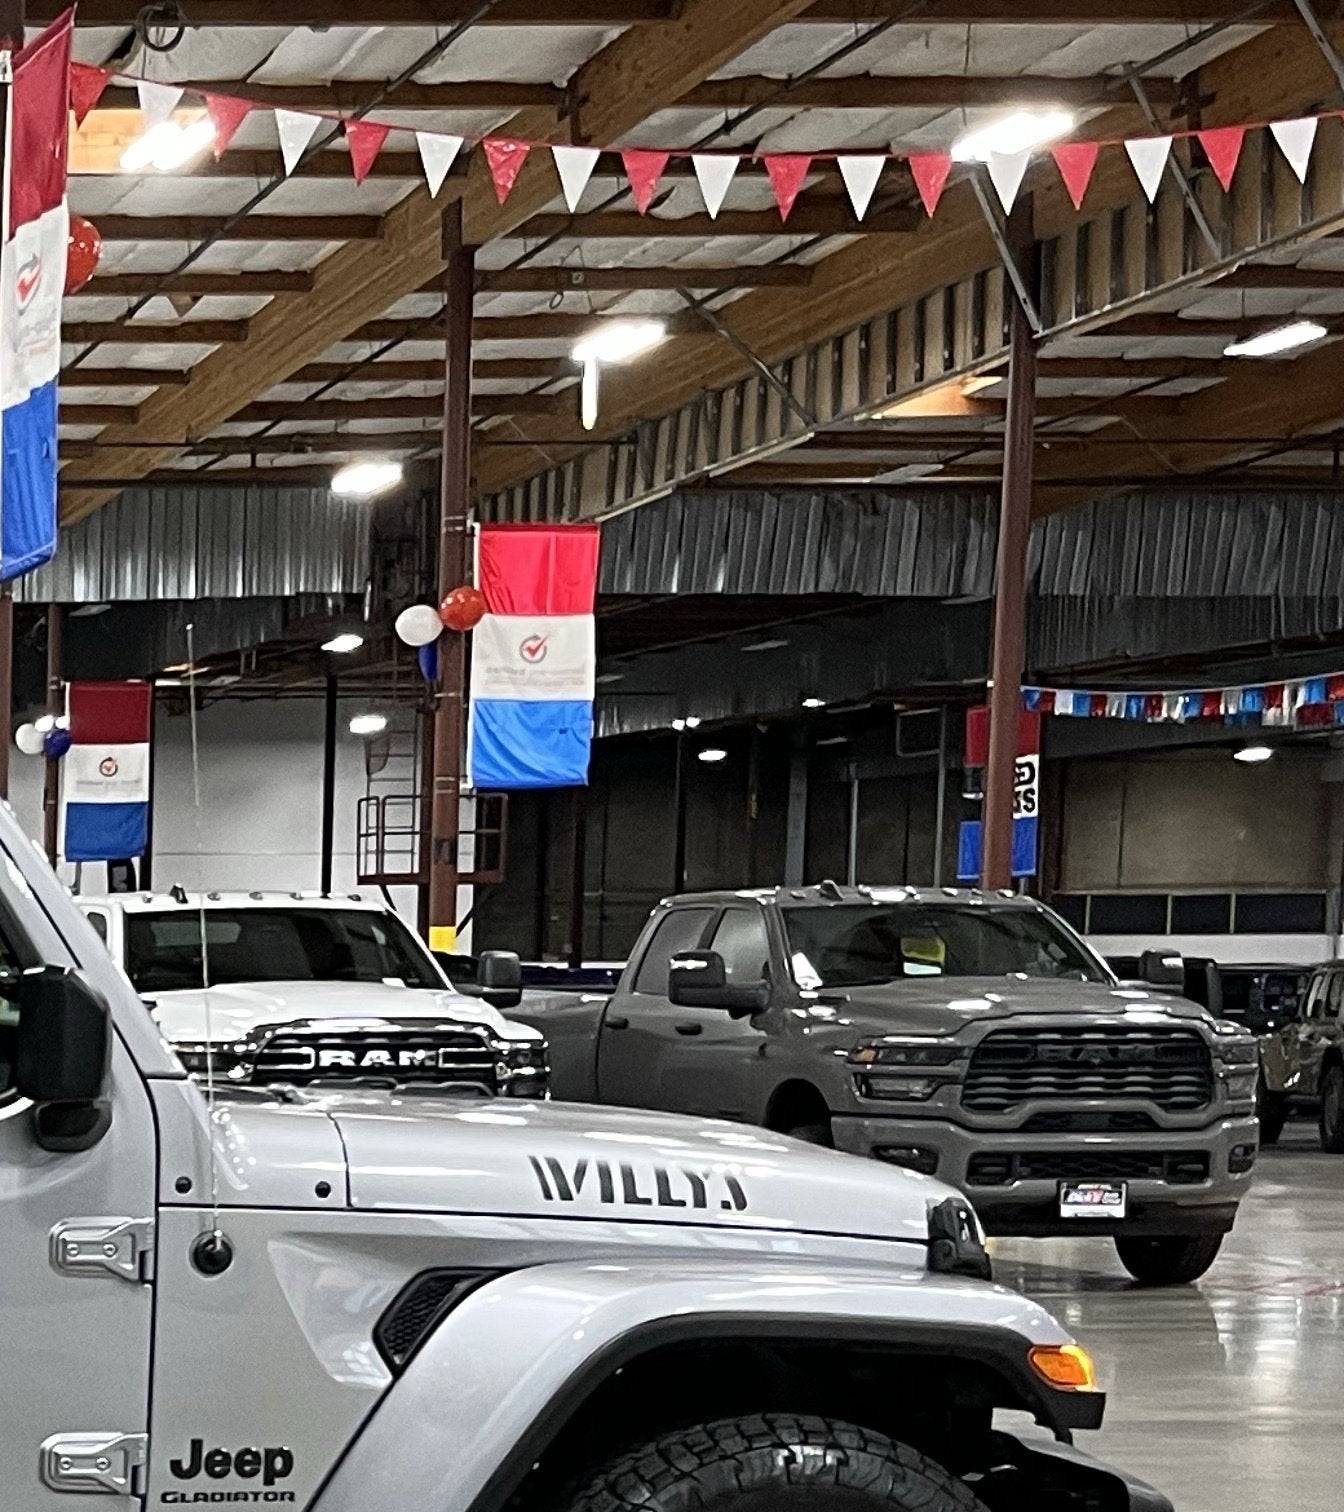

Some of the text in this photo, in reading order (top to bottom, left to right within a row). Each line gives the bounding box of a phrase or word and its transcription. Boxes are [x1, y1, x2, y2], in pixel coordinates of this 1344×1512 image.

[319, 1050, 437, 1067] RAM
[169, 1438, 294, 1486] Jeep
[160, 1491, 295, 1504] GLADIATOR
